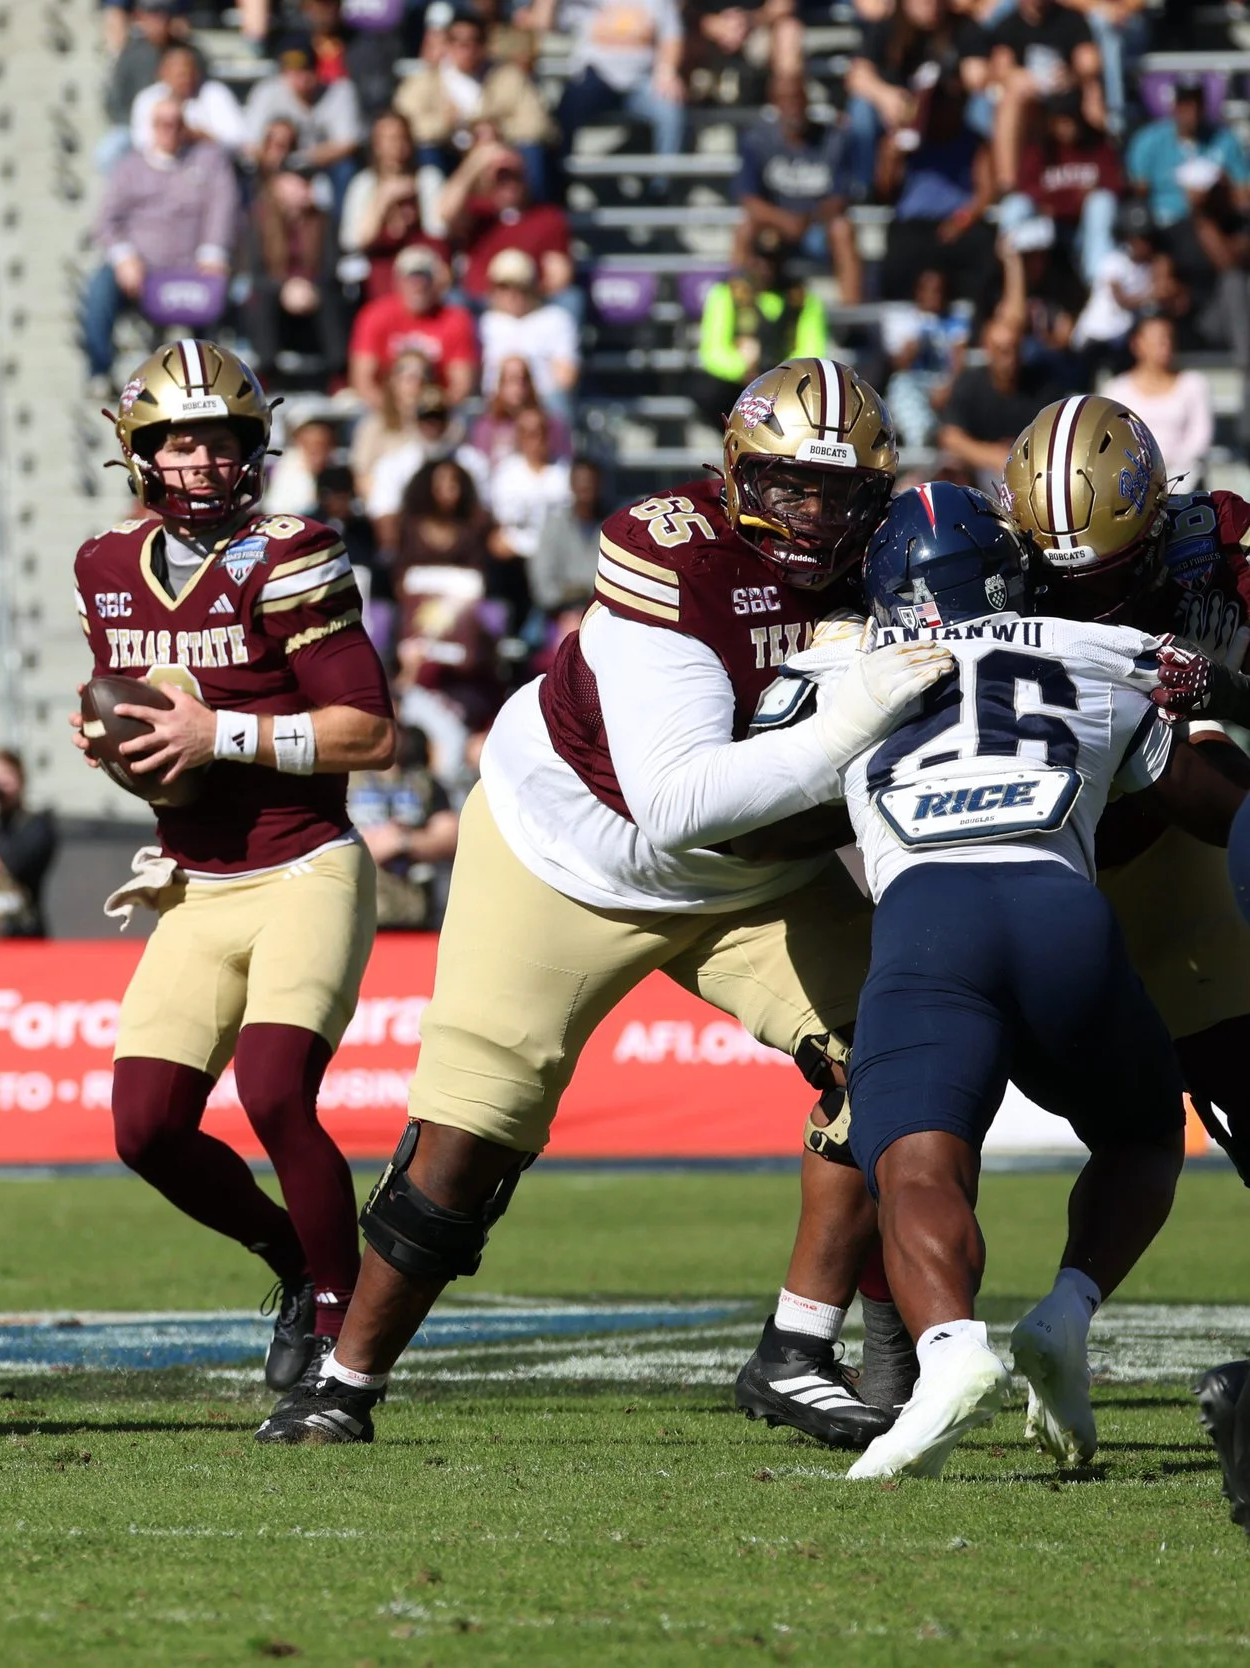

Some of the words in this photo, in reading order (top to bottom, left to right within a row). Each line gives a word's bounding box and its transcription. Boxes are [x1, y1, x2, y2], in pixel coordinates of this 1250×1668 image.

[182, 400, 218, 412] BOBCATS
[809, 445, 848, 460] BOBCATS
[629, 496, 718, 548] 65
[1047, 549, 1086, 562] BOBCATS
[94, 592, 133, 619] SBC
[733, 585, 782, 616] SBC
[105, 627, 171, 668] TEXAS
[177, 624, 249, 668] STATE
[866, 647, 1081, 792] 26
[912, 780, 1041, 821] RICE
[959, 815, 995, 825] DOUGLAS
